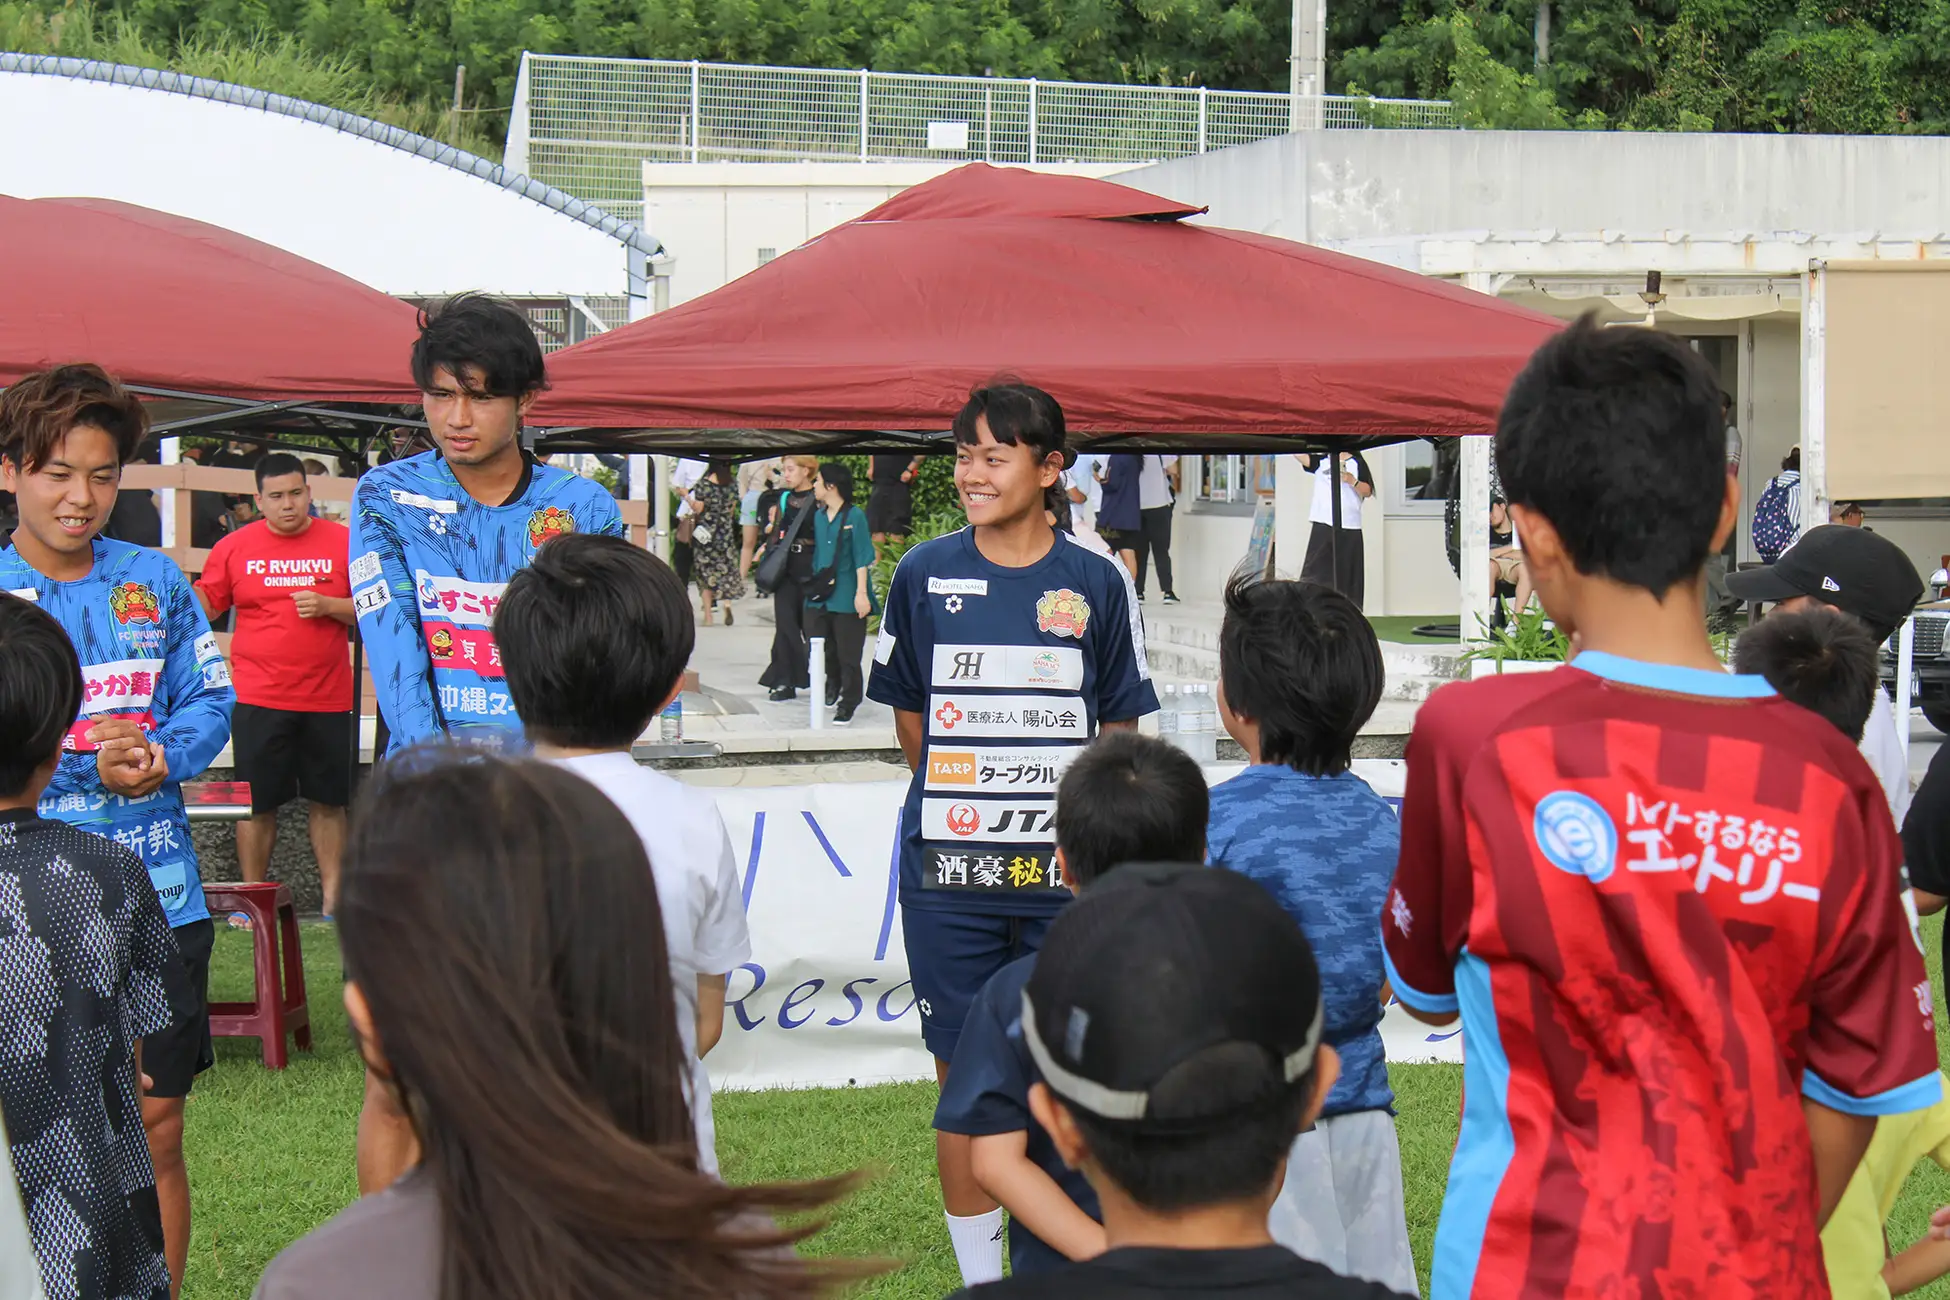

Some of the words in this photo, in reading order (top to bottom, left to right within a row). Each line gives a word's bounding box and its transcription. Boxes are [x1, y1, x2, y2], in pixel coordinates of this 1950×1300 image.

[246, 560, 266, 575] FC
[269, 559, 333, 574] RYUKYU
[264, 575, 316, 587] OKINAWA
[84, 671, 161, 702] やか薬
[437, 685, 516, 715] 沖縄タ
[967, 711, 1018, 724] 医療法人
[1023, 709, 1078, 728] 陽心会
[933, 762, 972, 775] TARP
[980, 764, 1064, 784] タープグル
